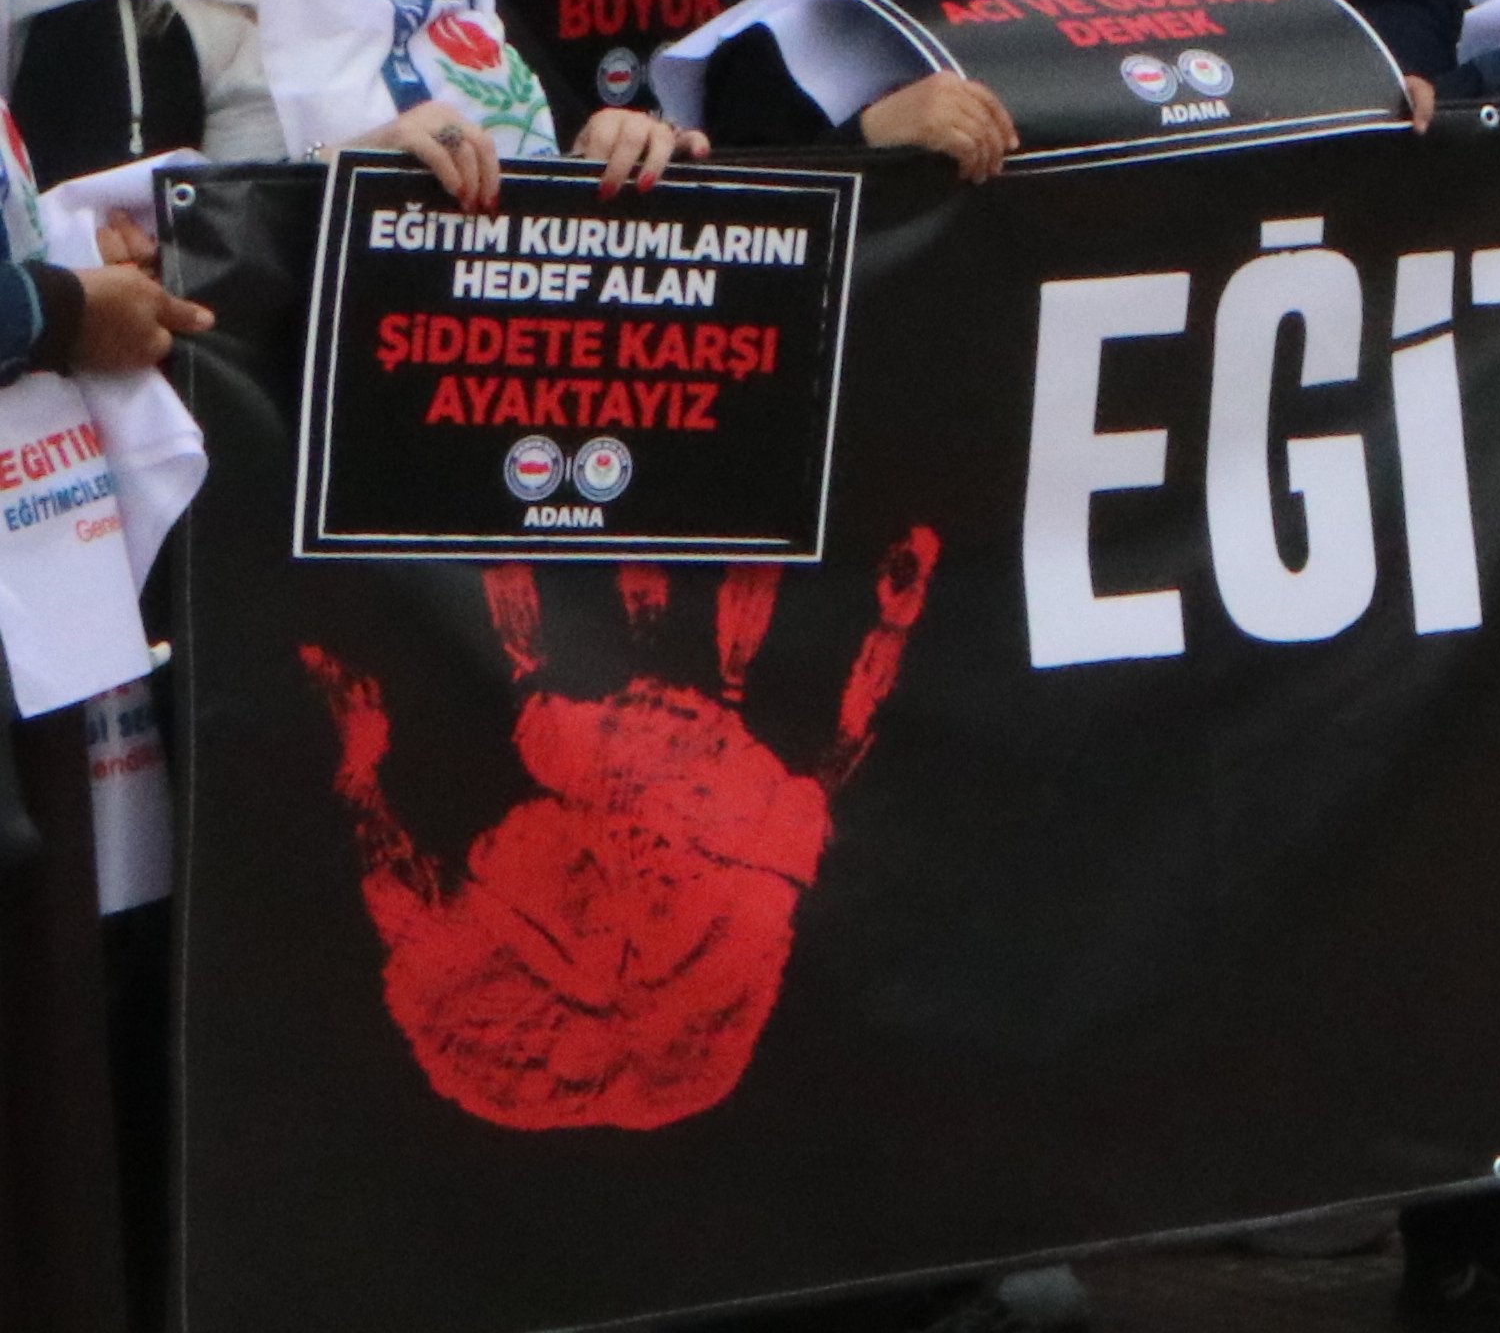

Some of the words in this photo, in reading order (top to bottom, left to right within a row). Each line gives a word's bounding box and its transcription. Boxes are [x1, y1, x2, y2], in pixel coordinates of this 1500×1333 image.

[1057, 7, 1227, 49] DEMEK
[1161, 100, 1230, 126] ADANA
[369, 203, 510, 253] EĞİTİM
[520, 215, 809, 265] KURUMLARINI
[452, 260, 591, 303] HEDEF
[600, 267, 717, 306] ALAN
[375, 312, 603, 372] ŞİDDETE
[617, 320, 780, 379] KARŞI
[424, 376, 720, 431] AYAKTAYIZ
[523, 505, 604, 527] ADANA
